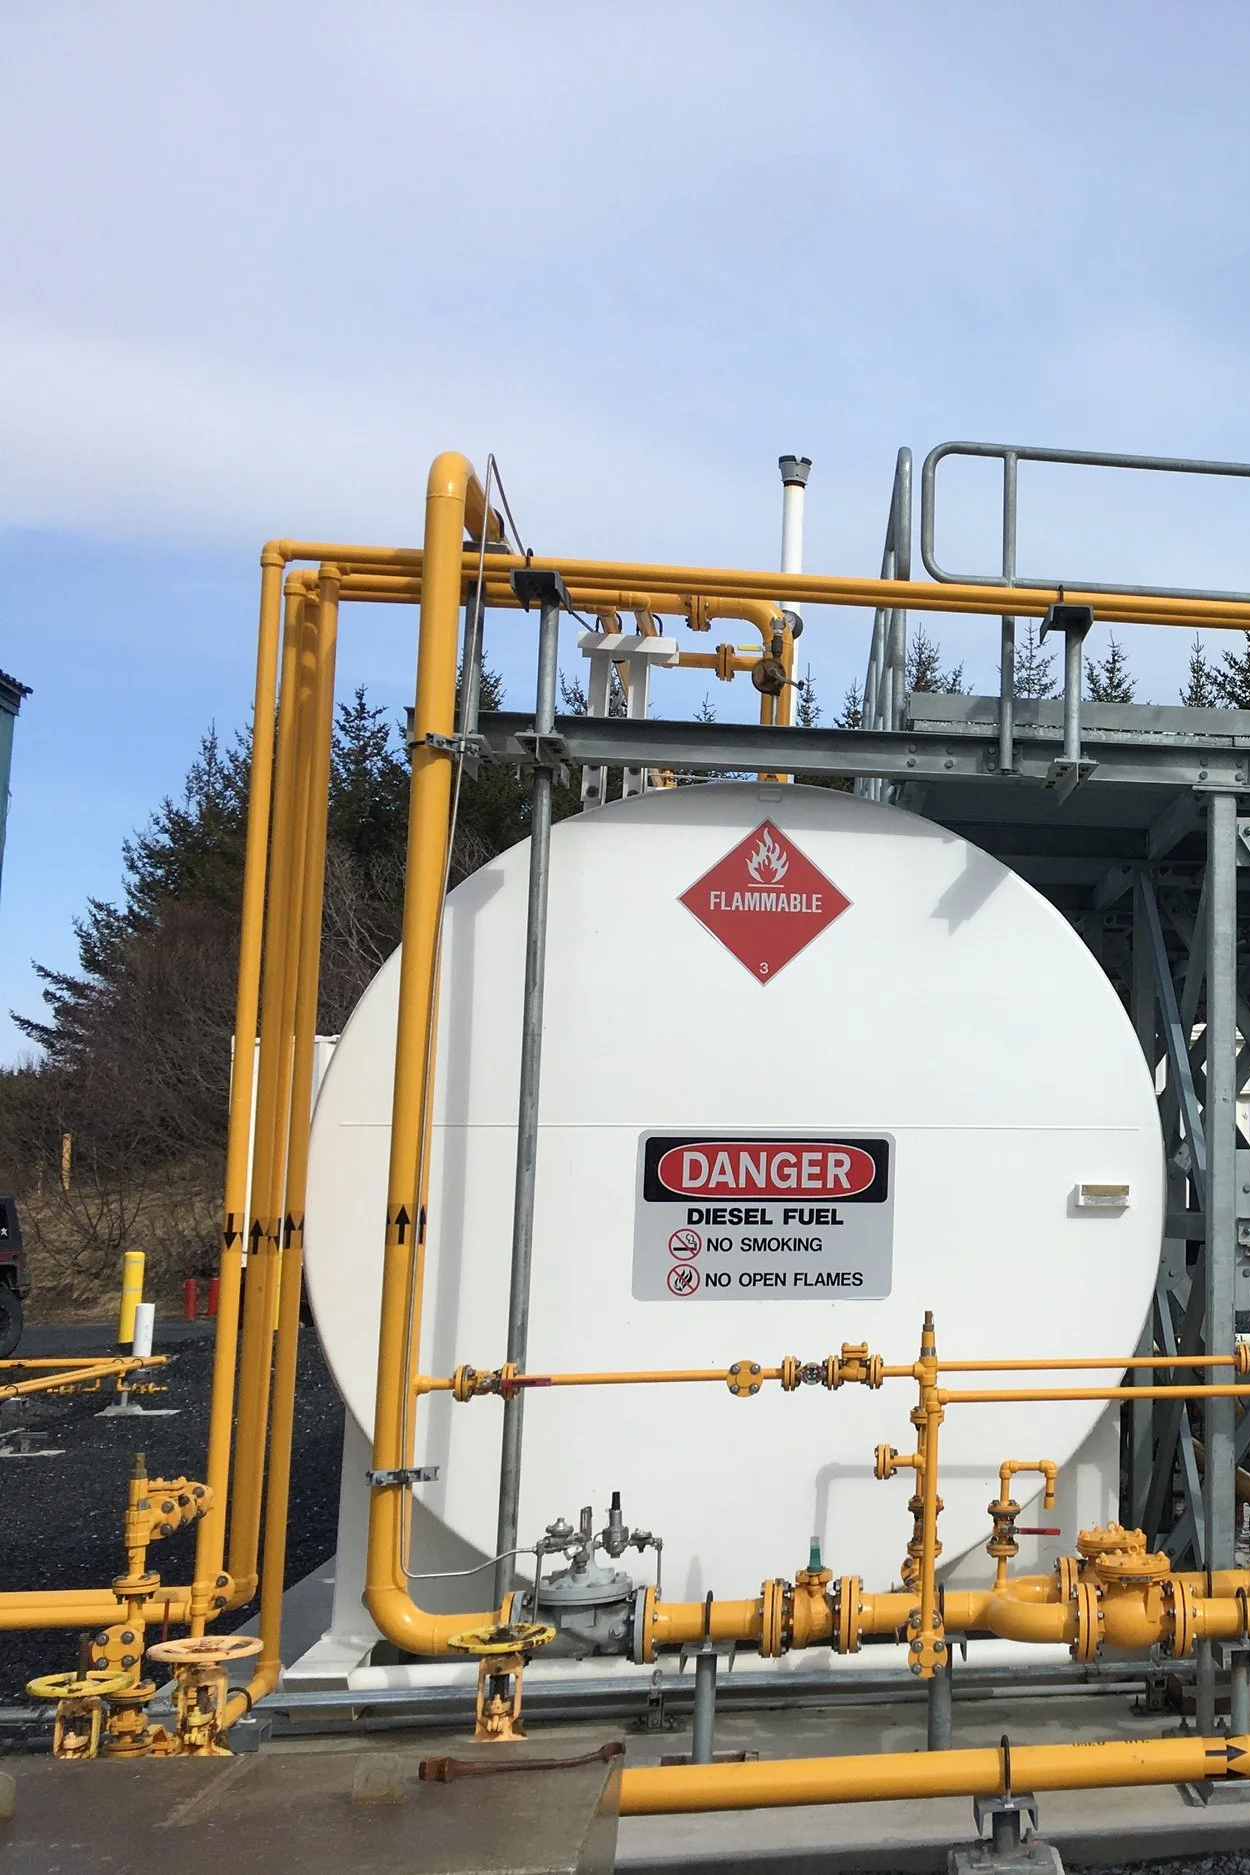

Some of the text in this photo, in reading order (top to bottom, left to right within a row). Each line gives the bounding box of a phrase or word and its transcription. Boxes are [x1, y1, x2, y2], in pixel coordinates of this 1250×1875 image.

[710, 891, 822, 913] FLAMMABLE
[759, 962, 769, 974] 3
[681, 1151, 852, 1189] DANGER
[687, 1208, 844, 1226] DIESEL FUEL
[706, 1237, 822, 1252] NO SMOKING
[705, 1271, 863, 1288] NO OPEN FLAMES
